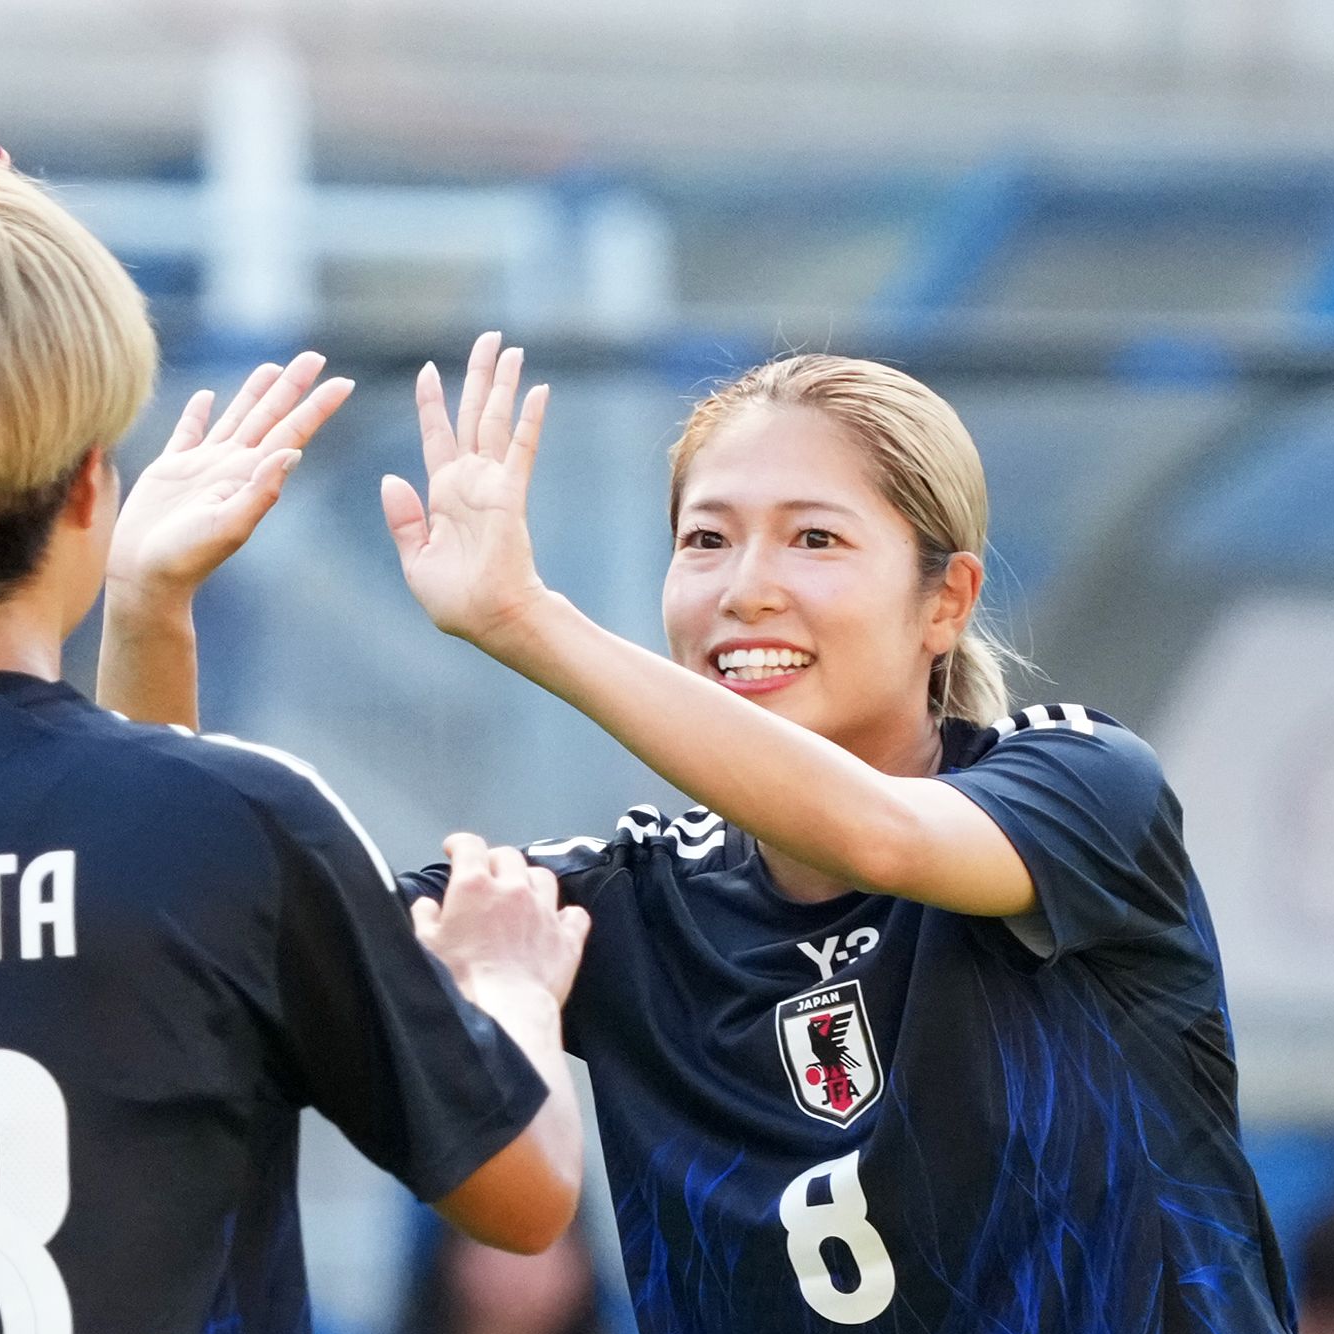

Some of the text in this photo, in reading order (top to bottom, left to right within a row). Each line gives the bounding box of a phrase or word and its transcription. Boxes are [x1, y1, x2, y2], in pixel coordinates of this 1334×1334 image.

[796, 991, 841, 1013] JAPAN
[821, 1079, 862, 1106] JFA
[779, 1150, 896, 1325] 8
